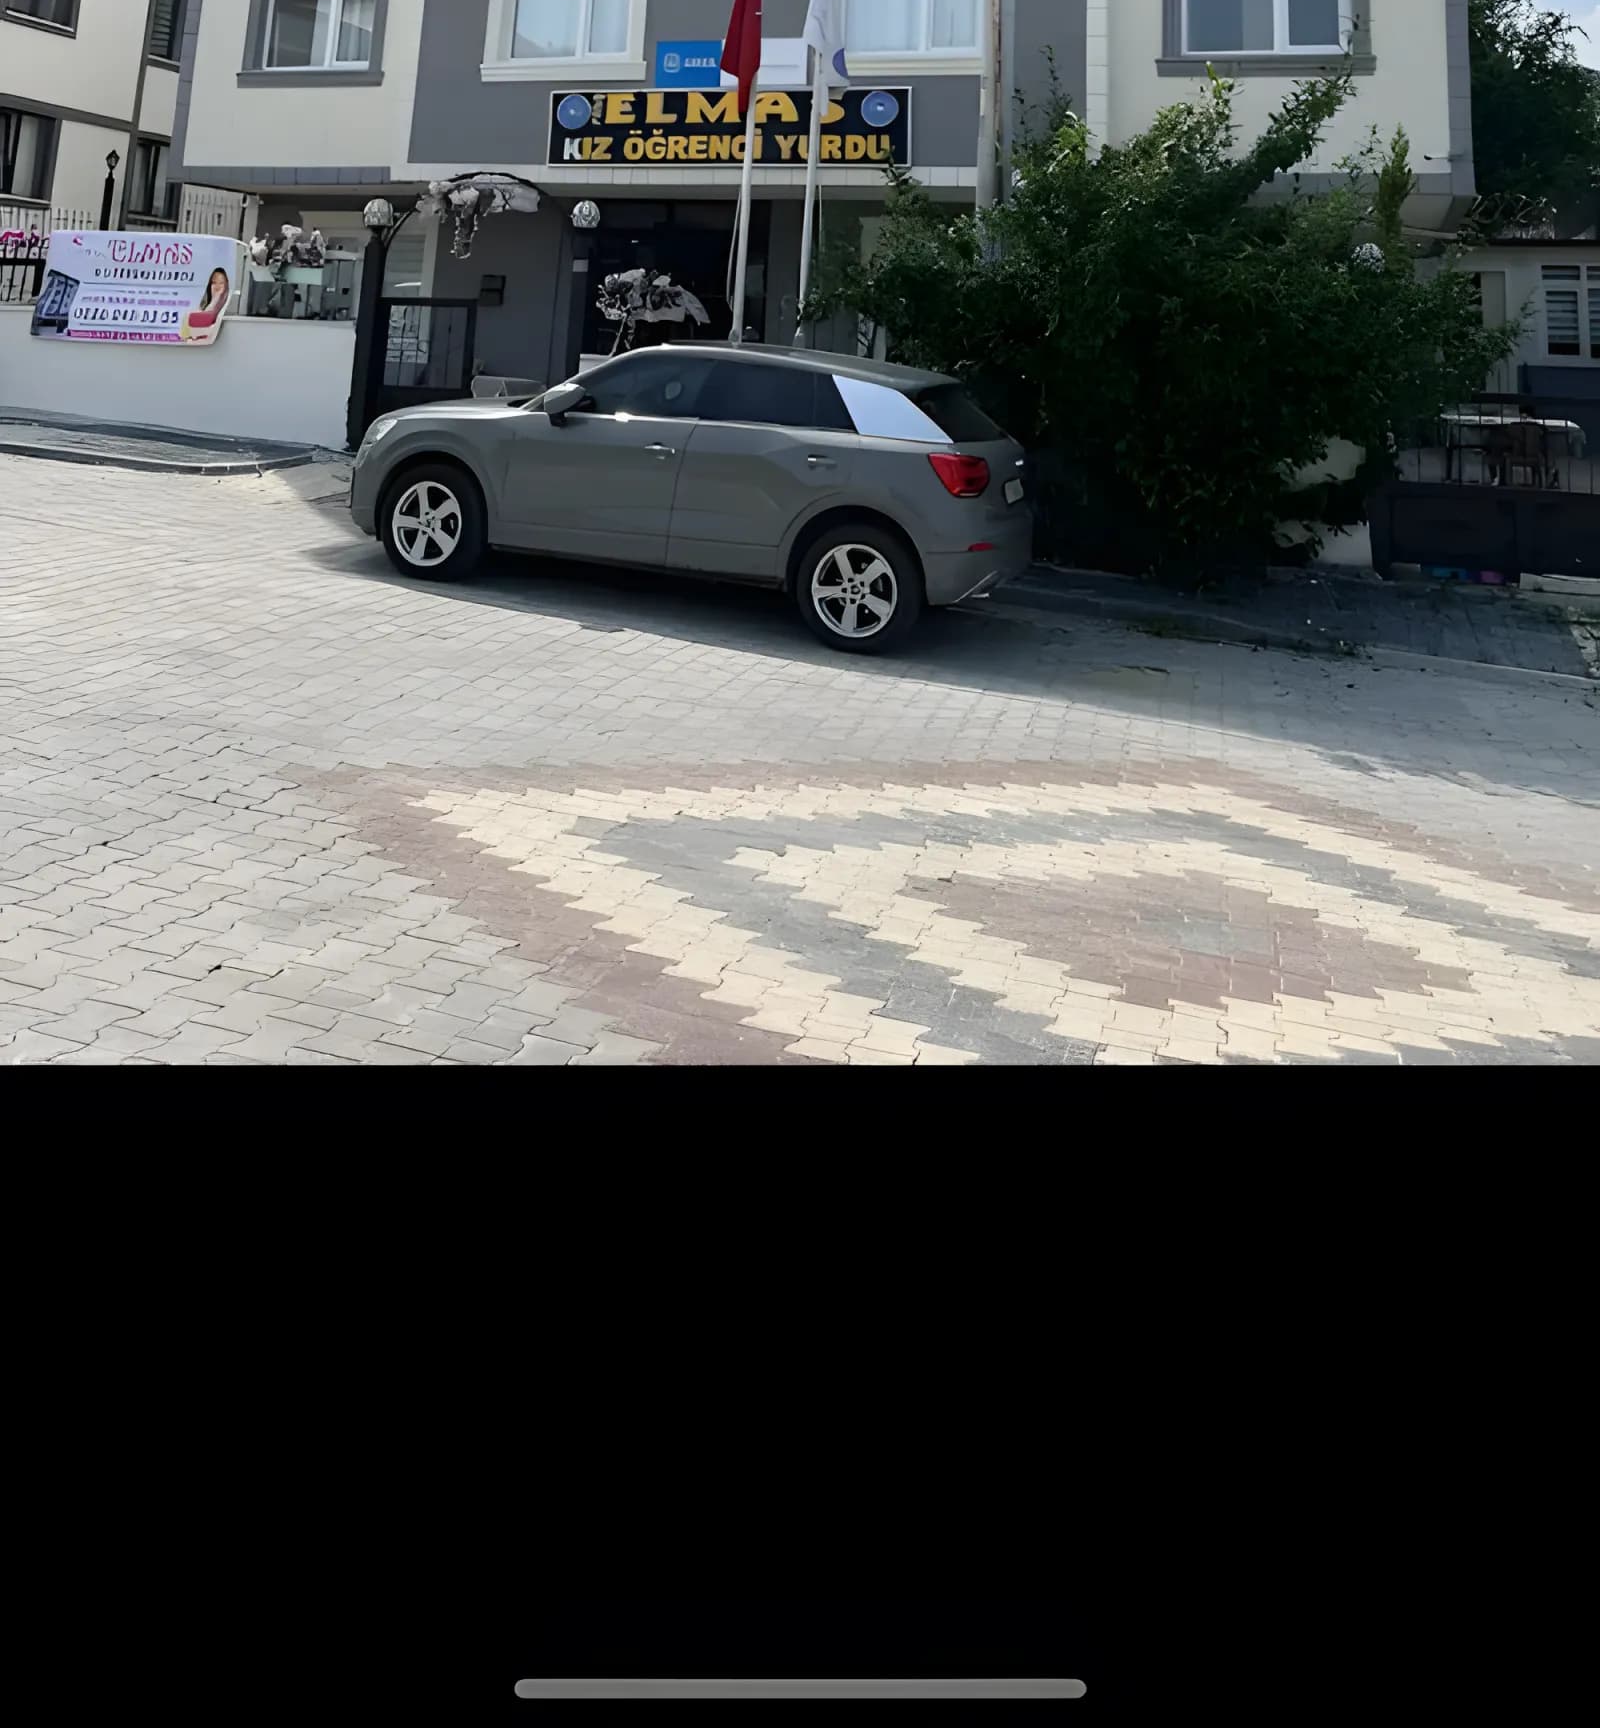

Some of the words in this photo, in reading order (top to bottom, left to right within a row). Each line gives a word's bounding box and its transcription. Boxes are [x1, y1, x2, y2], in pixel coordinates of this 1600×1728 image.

[563, 136, 614, 161] KIZ
[623, 128, 763, 161] ÖĞRENCİ
[774, 134, 892, 161] YURDU
